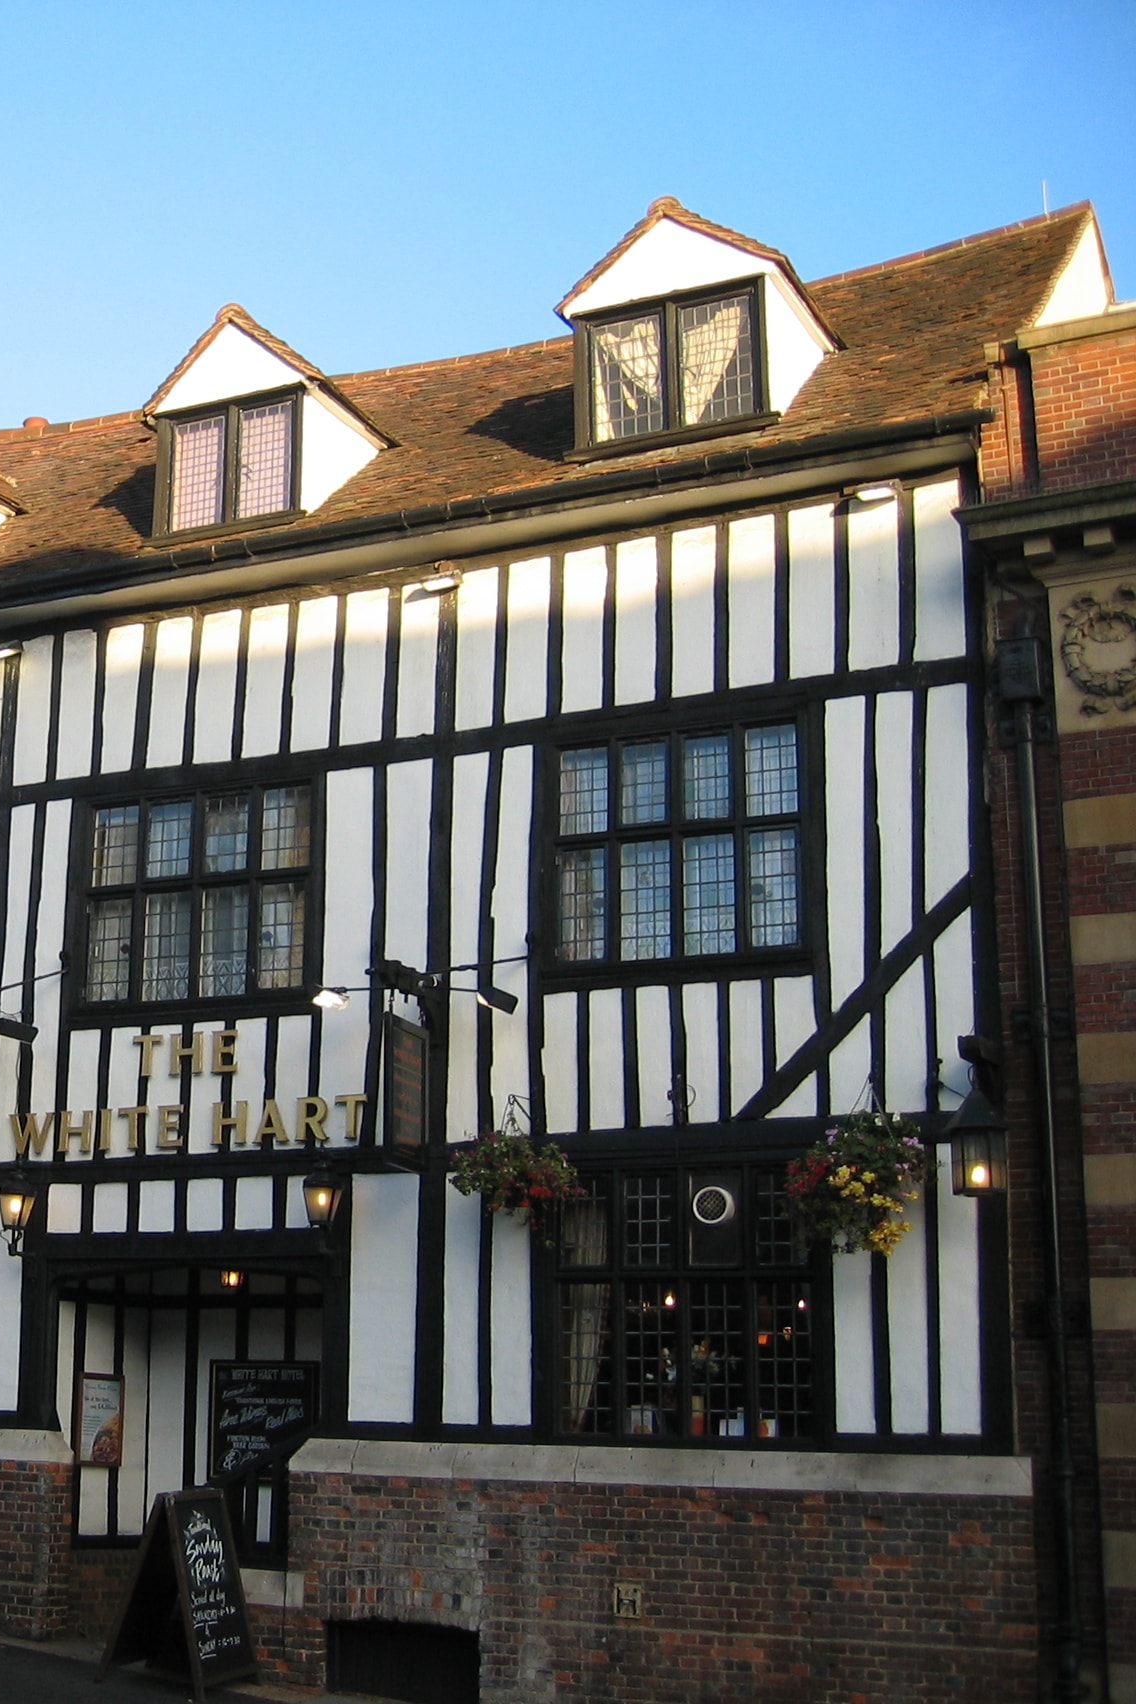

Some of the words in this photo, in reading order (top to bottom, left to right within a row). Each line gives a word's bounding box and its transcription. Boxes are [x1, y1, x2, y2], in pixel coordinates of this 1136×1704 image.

[133, 1029, 239, 1077] THE
[9, 1104, 185, 1155] WHITE
[211, 1094, 368, 1146] HART
[186, 1533, 223, 1565] Sunday
